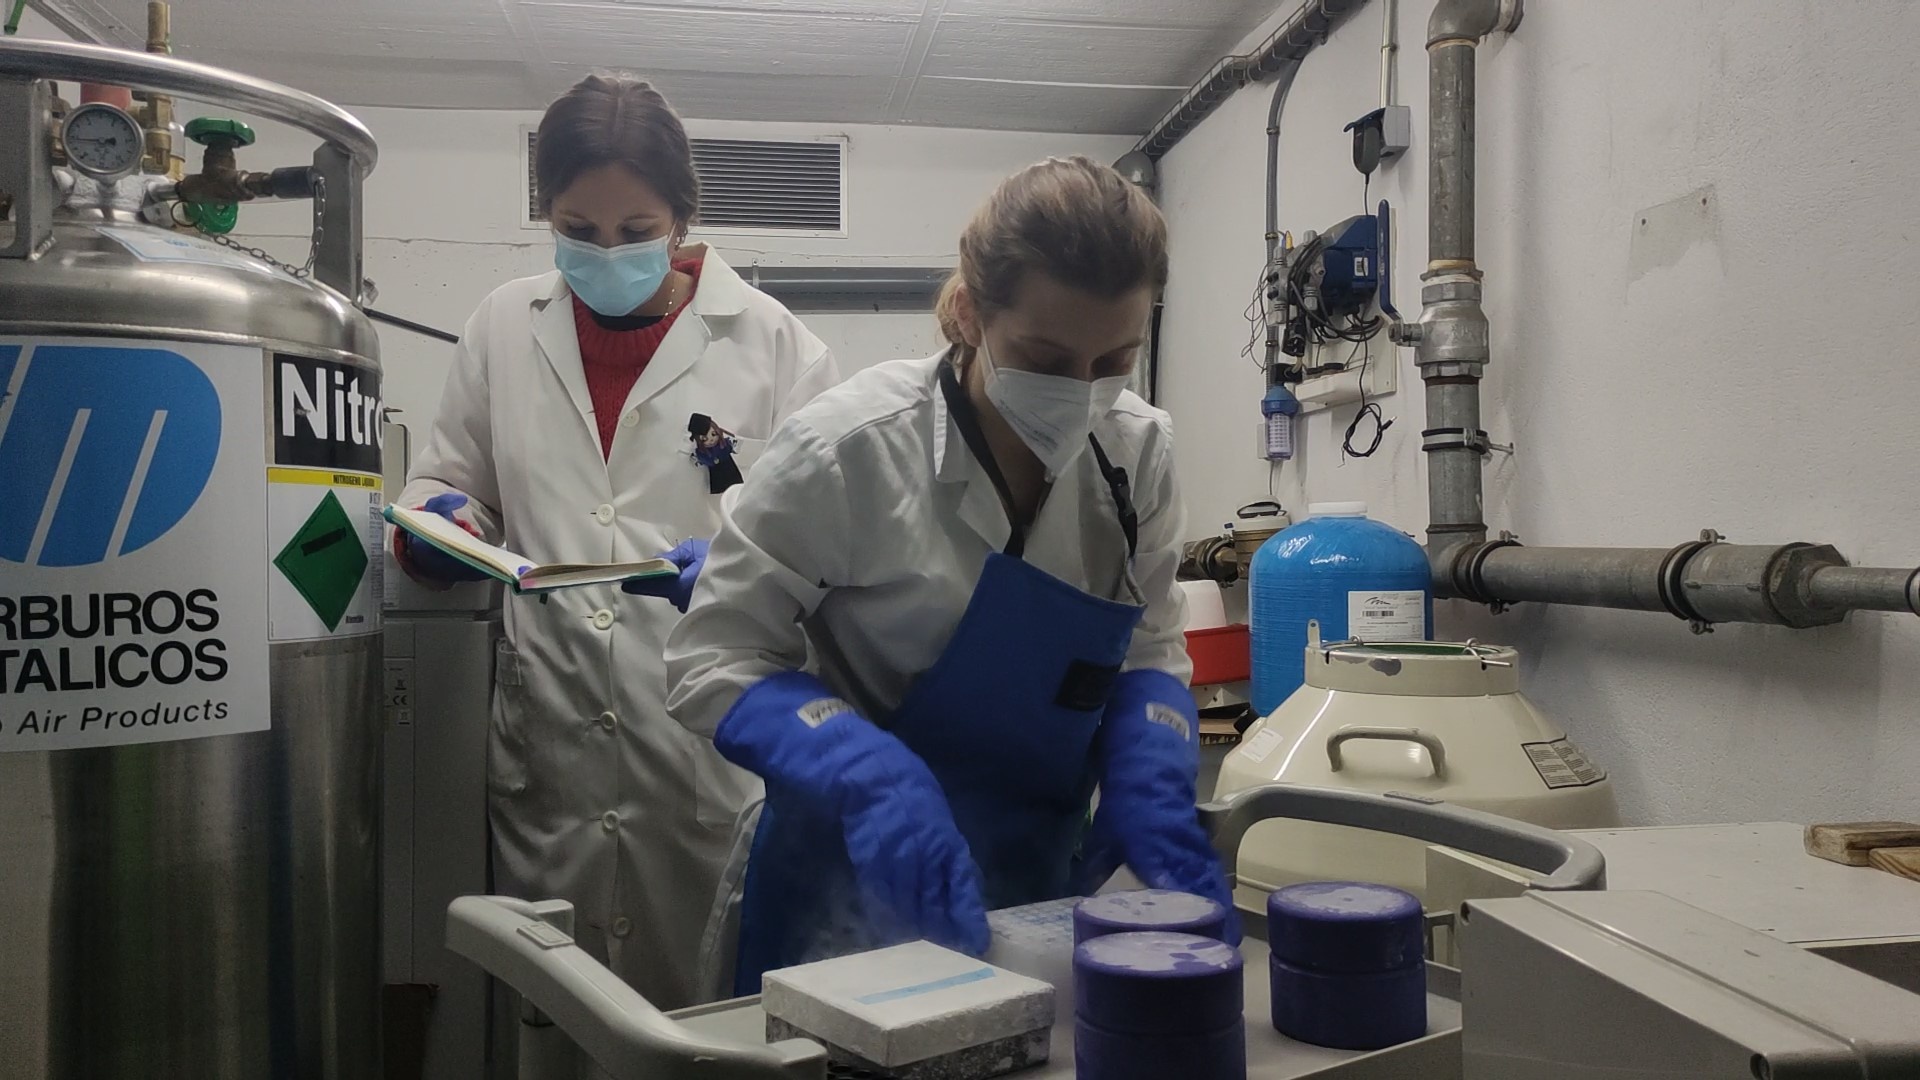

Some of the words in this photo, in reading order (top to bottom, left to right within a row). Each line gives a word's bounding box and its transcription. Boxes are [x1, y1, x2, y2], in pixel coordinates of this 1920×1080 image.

[0, 638, 228, 694] TALICOS
[17, 709, 67, 735] Air
[80, 699, 228, 731] Products
